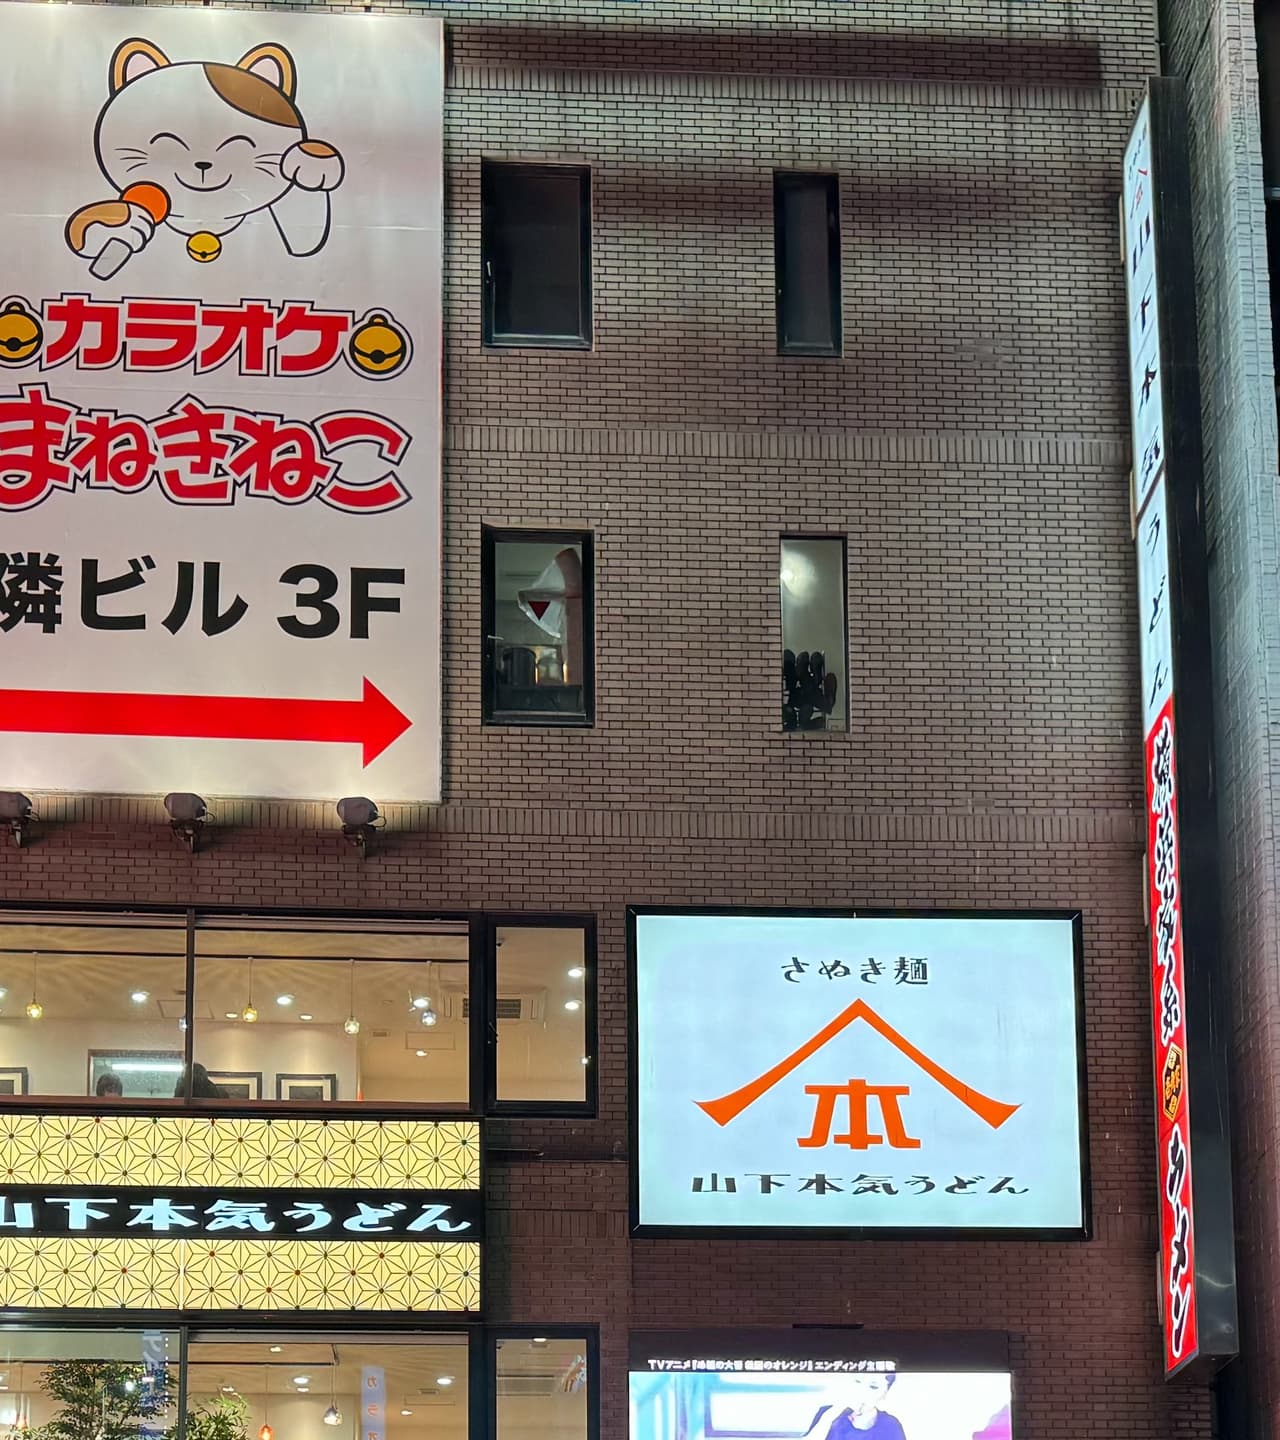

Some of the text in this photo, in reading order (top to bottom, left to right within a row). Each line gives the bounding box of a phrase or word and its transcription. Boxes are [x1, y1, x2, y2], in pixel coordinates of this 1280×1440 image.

[40, 294, 355, 377] カラオケ
[276, 564, 406, 639] 3F
[781, 956, 929, 985] さぬき麺
[692, 1173, 1029, 1195] 山下本気うどん
